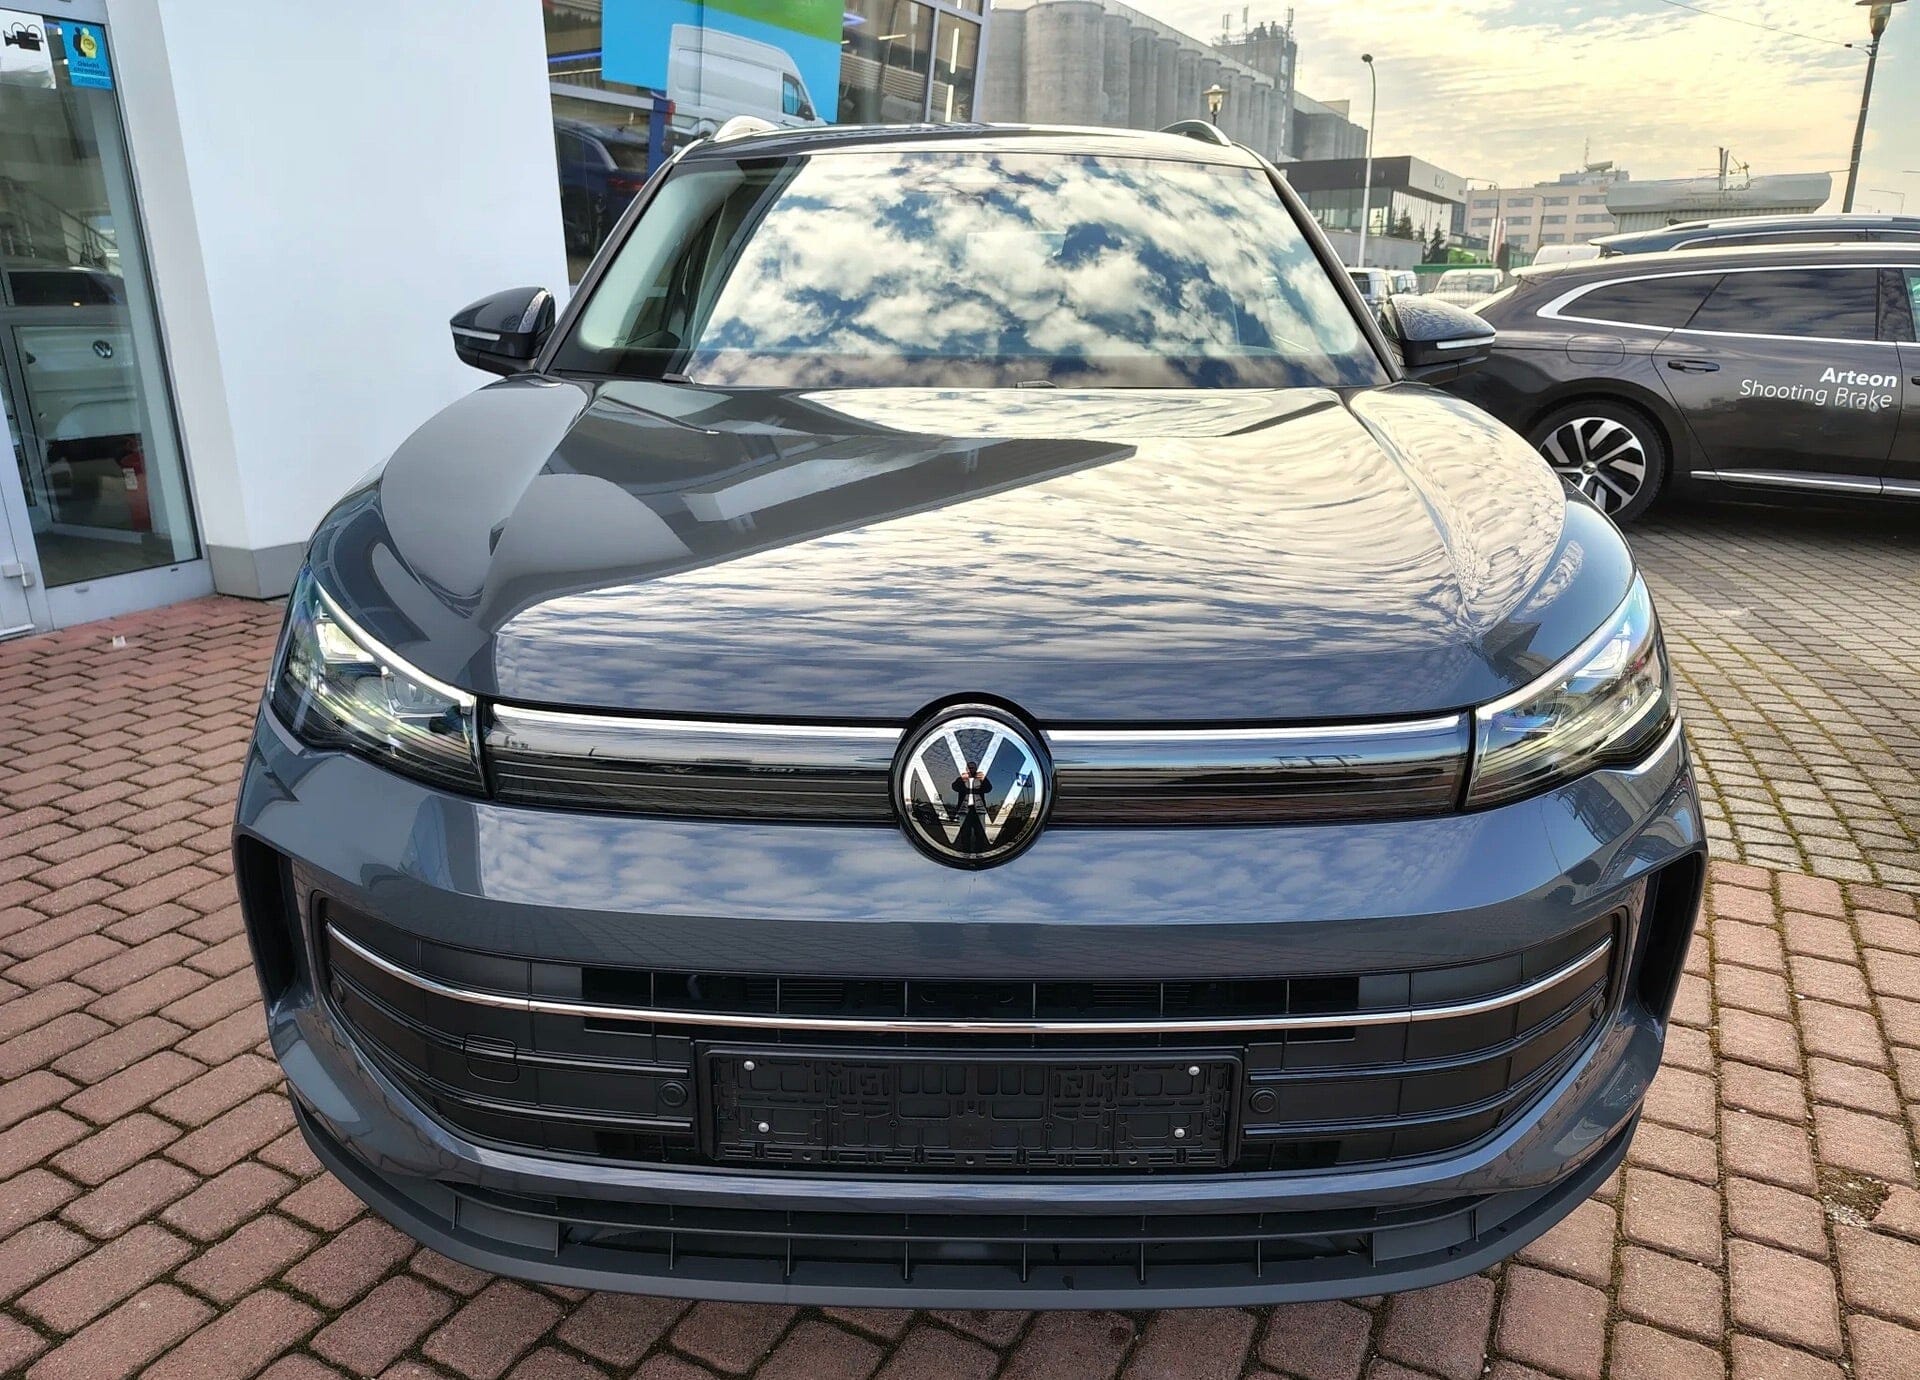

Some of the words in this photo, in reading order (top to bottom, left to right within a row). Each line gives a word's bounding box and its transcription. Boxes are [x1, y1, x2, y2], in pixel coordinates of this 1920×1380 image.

[1820, 367, 1898, 387] Arteon
[1739, 380, 1828, 406] Shooting
[1834, 387, 1893, 411] Brake
